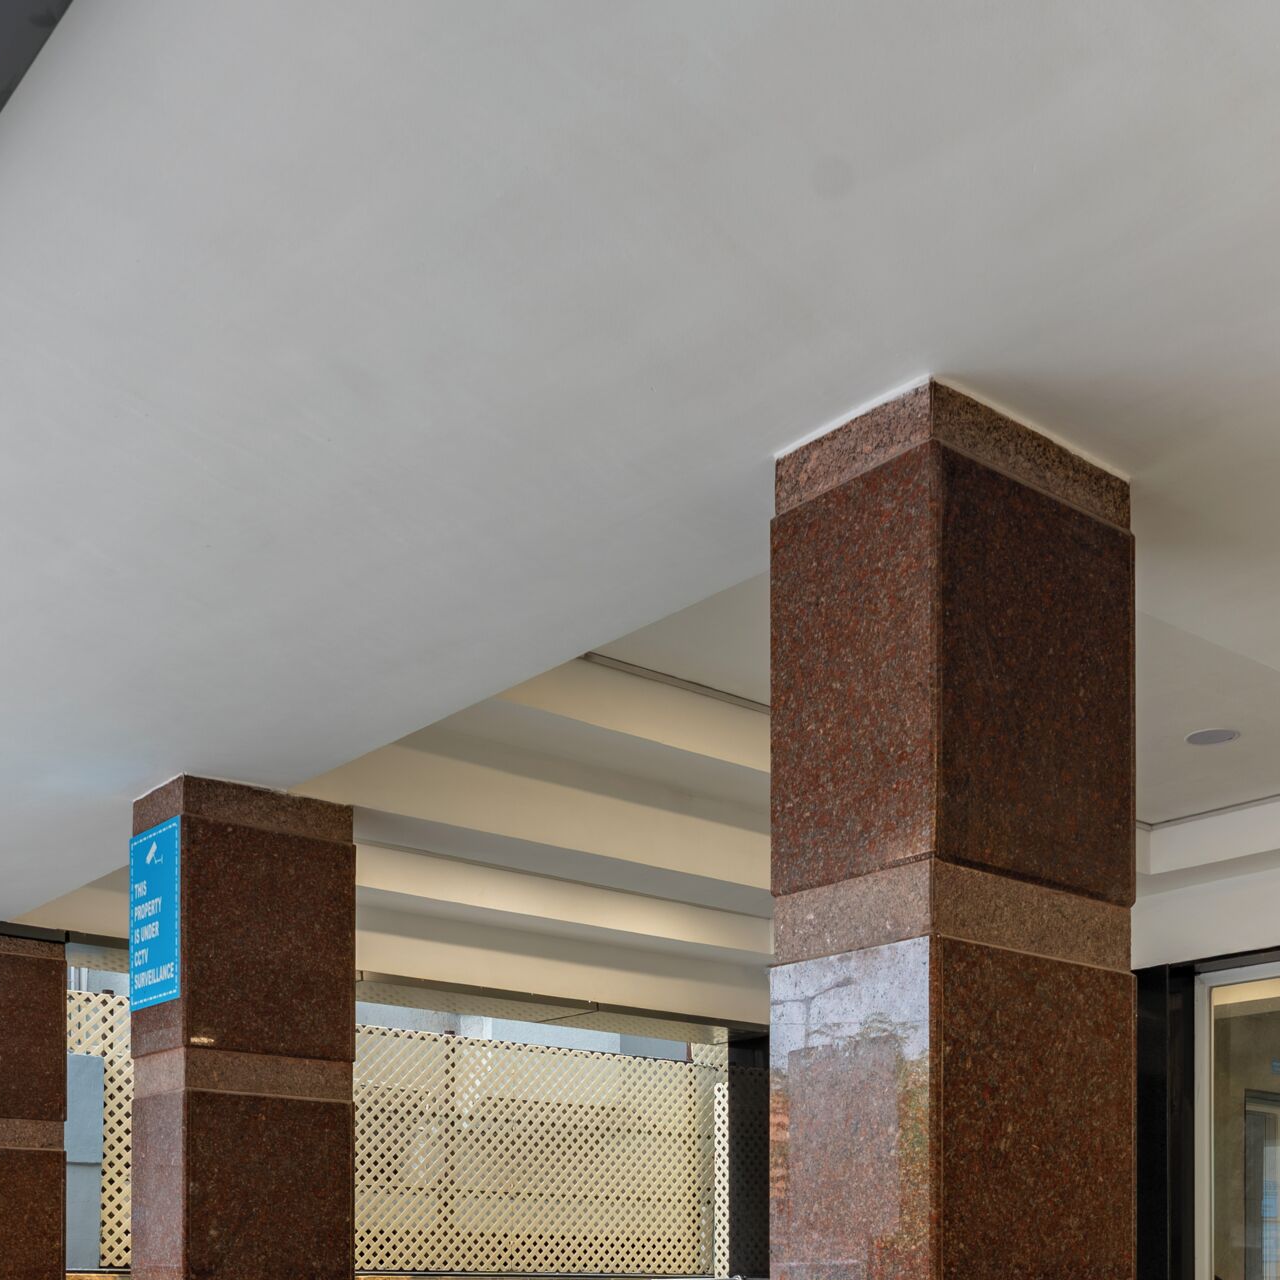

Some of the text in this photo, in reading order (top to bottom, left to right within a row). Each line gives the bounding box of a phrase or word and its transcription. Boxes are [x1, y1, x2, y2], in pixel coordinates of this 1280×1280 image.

[134, 880, 147, 899] THIS
[134, 896, 162, 922] PROPERTY
[134, 920, 160, 945] IS UNDER
[134, 947, 149, 968] CCTV
[134, 962, 174, 990] SURVEILLANCE
